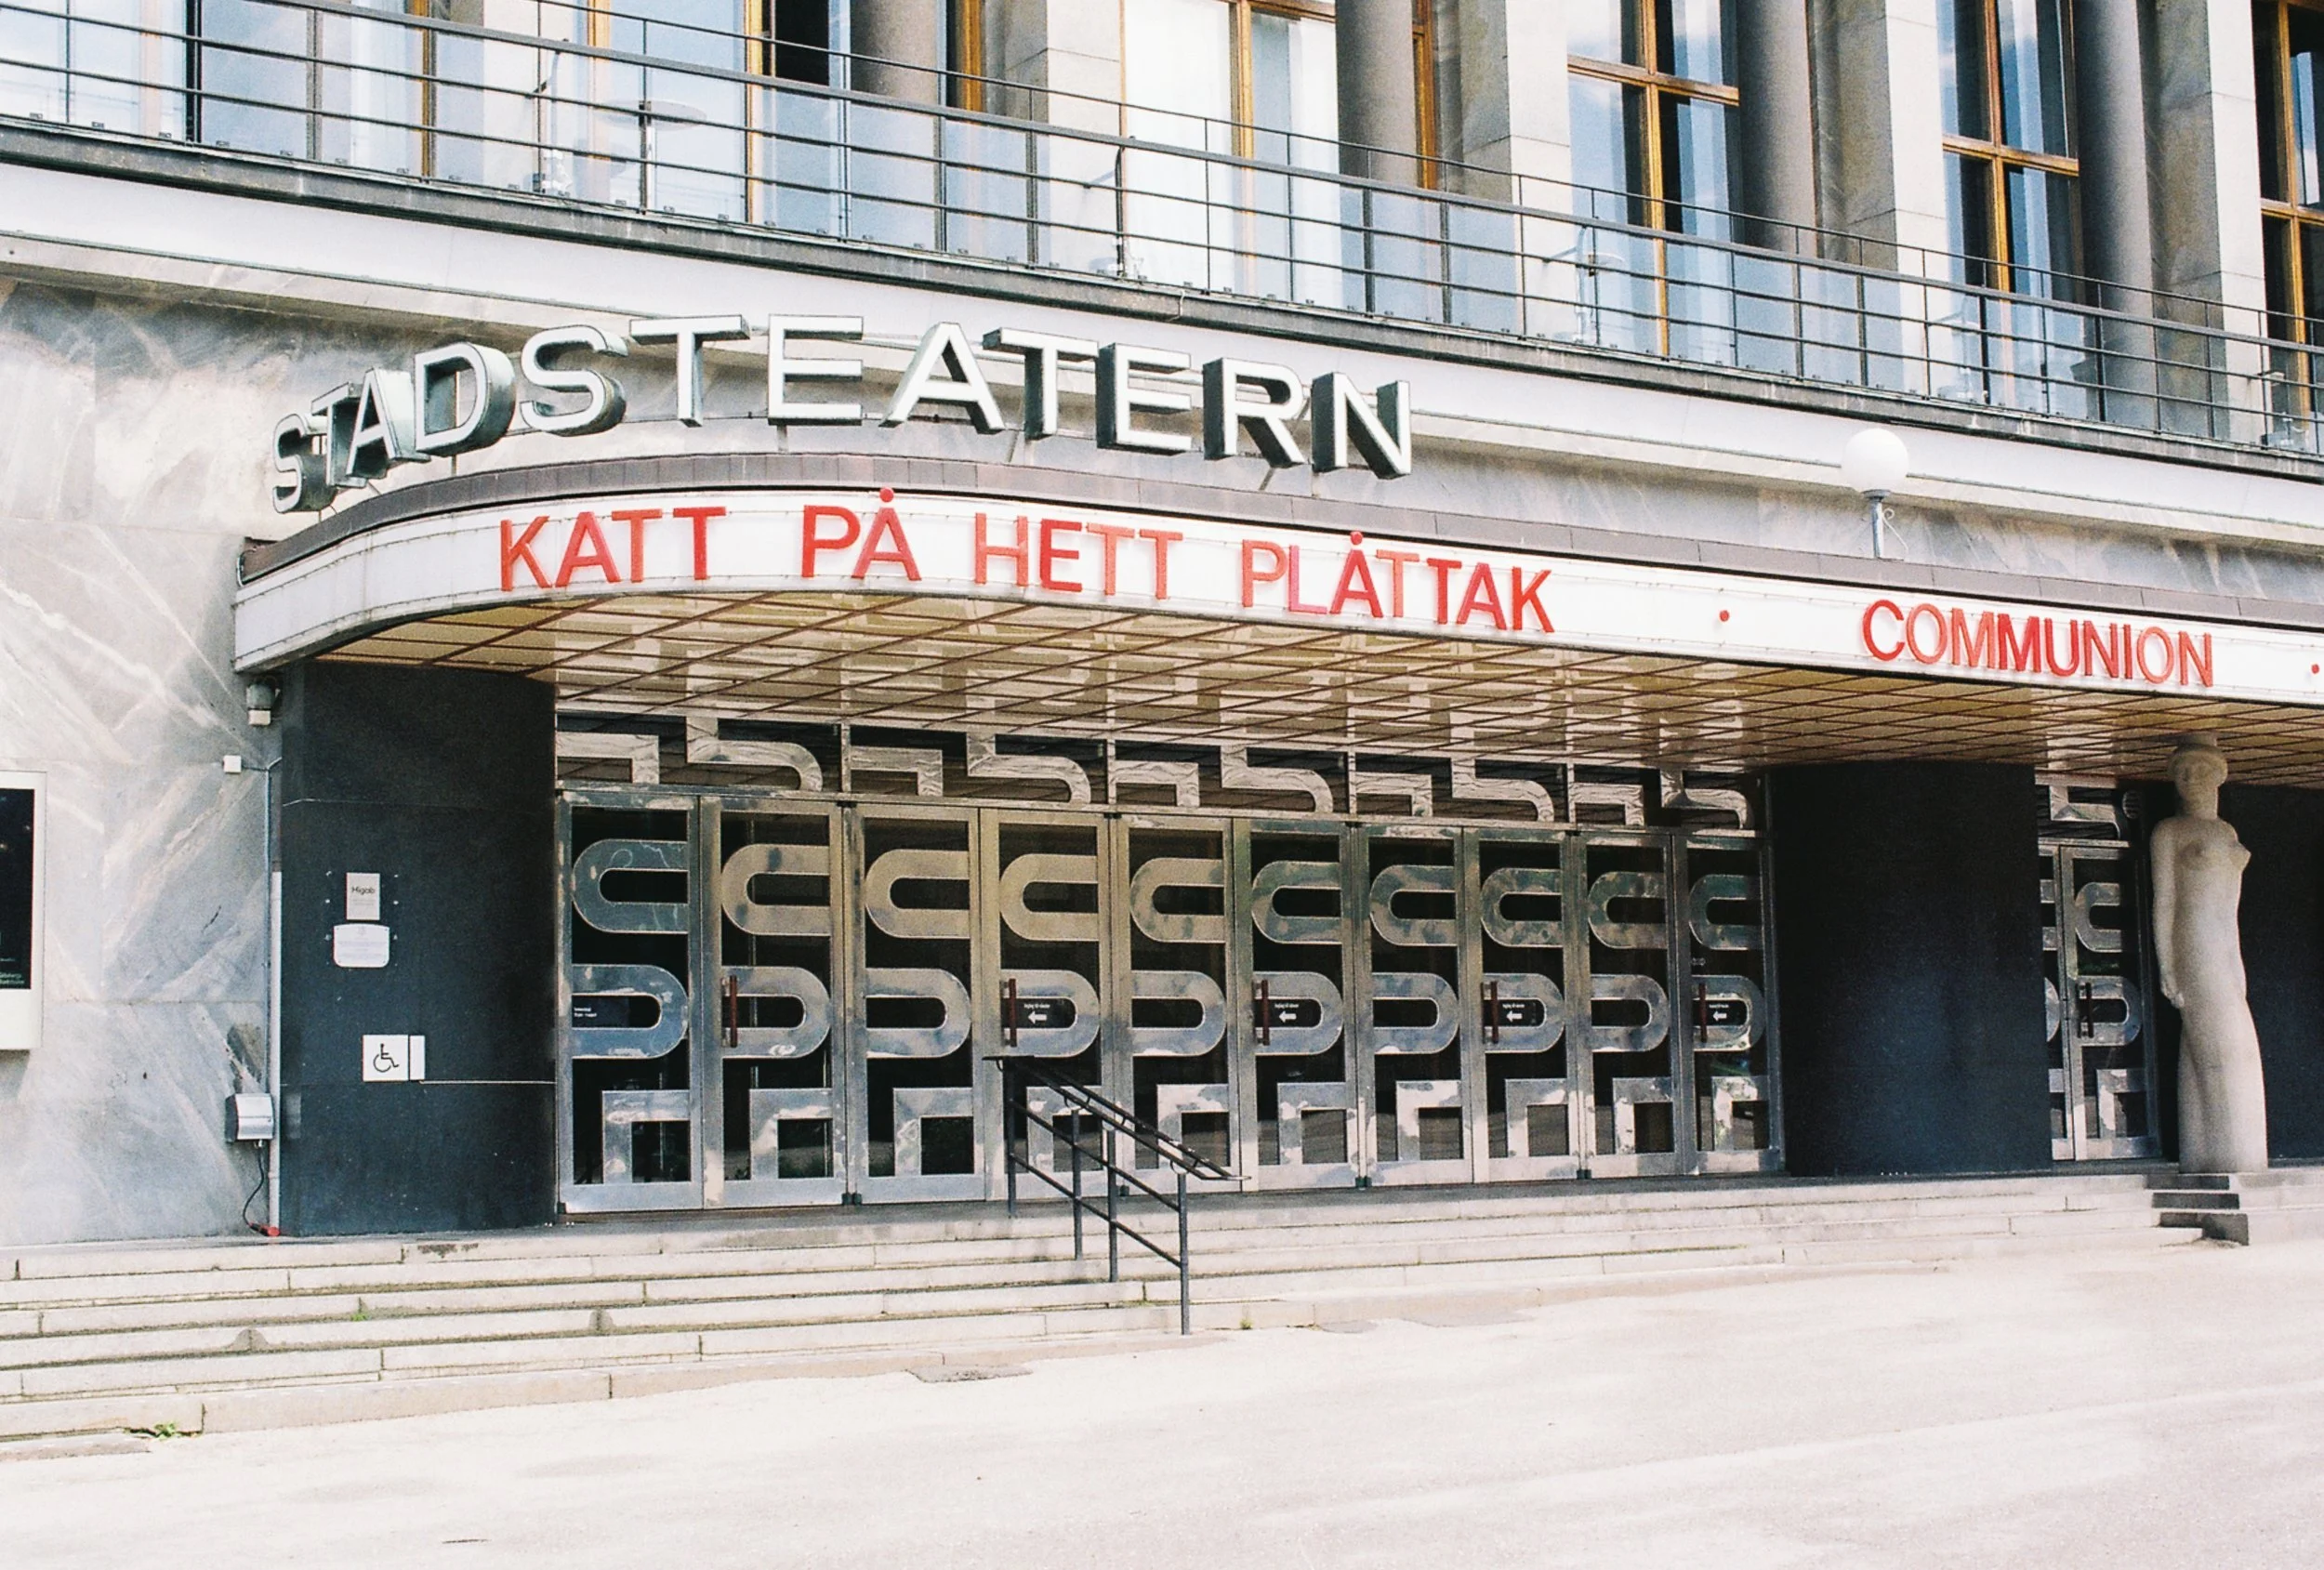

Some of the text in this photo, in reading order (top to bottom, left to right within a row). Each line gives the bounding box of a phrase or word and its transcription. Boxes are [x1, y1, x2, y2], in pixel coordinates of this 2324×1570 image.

[272, 314, 1412, 512] STADSTEATERN
[500, 487, 2212, 688] KATT PÅ HETT PLÅTTAK COMMUNION
[350, 885, 376, 895] Higab
